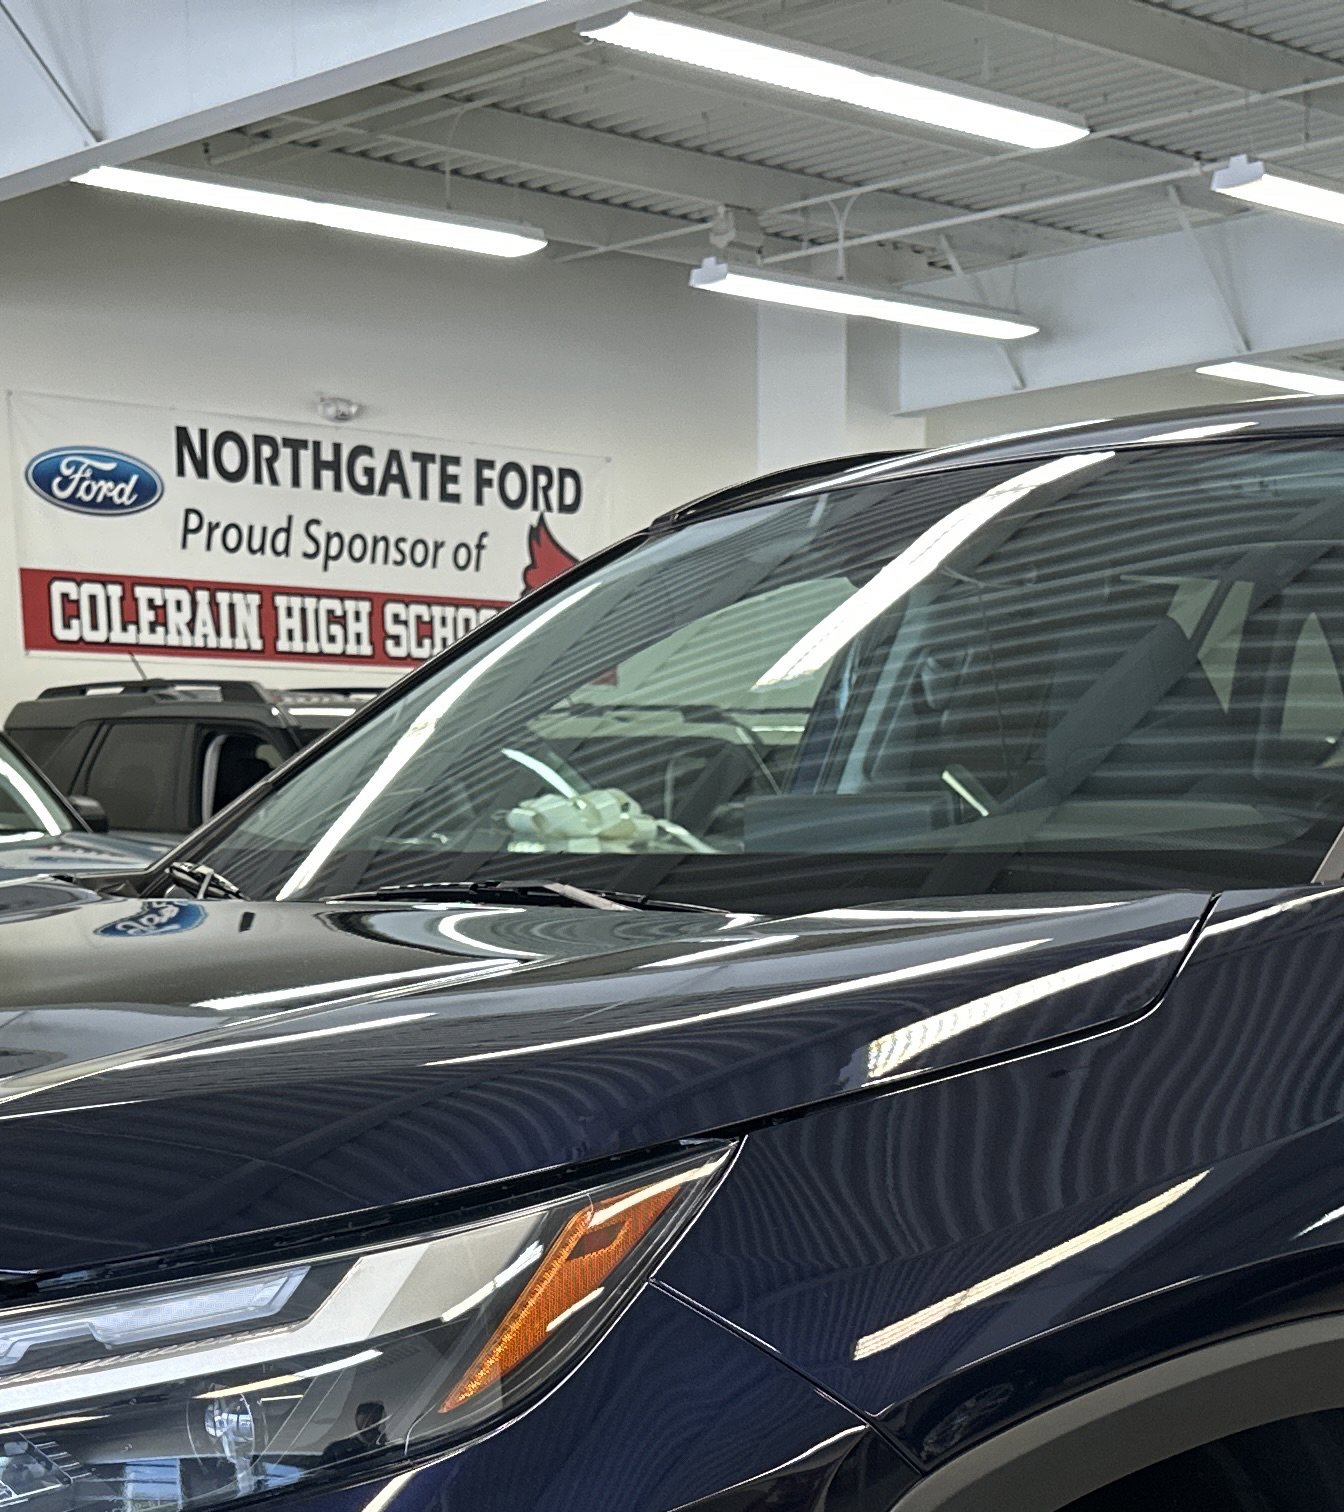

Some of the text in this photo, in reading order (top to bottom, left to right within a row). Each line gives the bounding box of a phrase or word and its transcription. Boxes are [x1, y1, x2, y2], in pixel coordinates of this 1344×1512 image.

[51, 455, 139, 506] Ford
[175, 426, 582, 514] NORTHGATE FORD
[181, 507, 490, 573] Proud Sponsor of
[48, 578, 500, 660] COLERAIN HIGH SCHO
